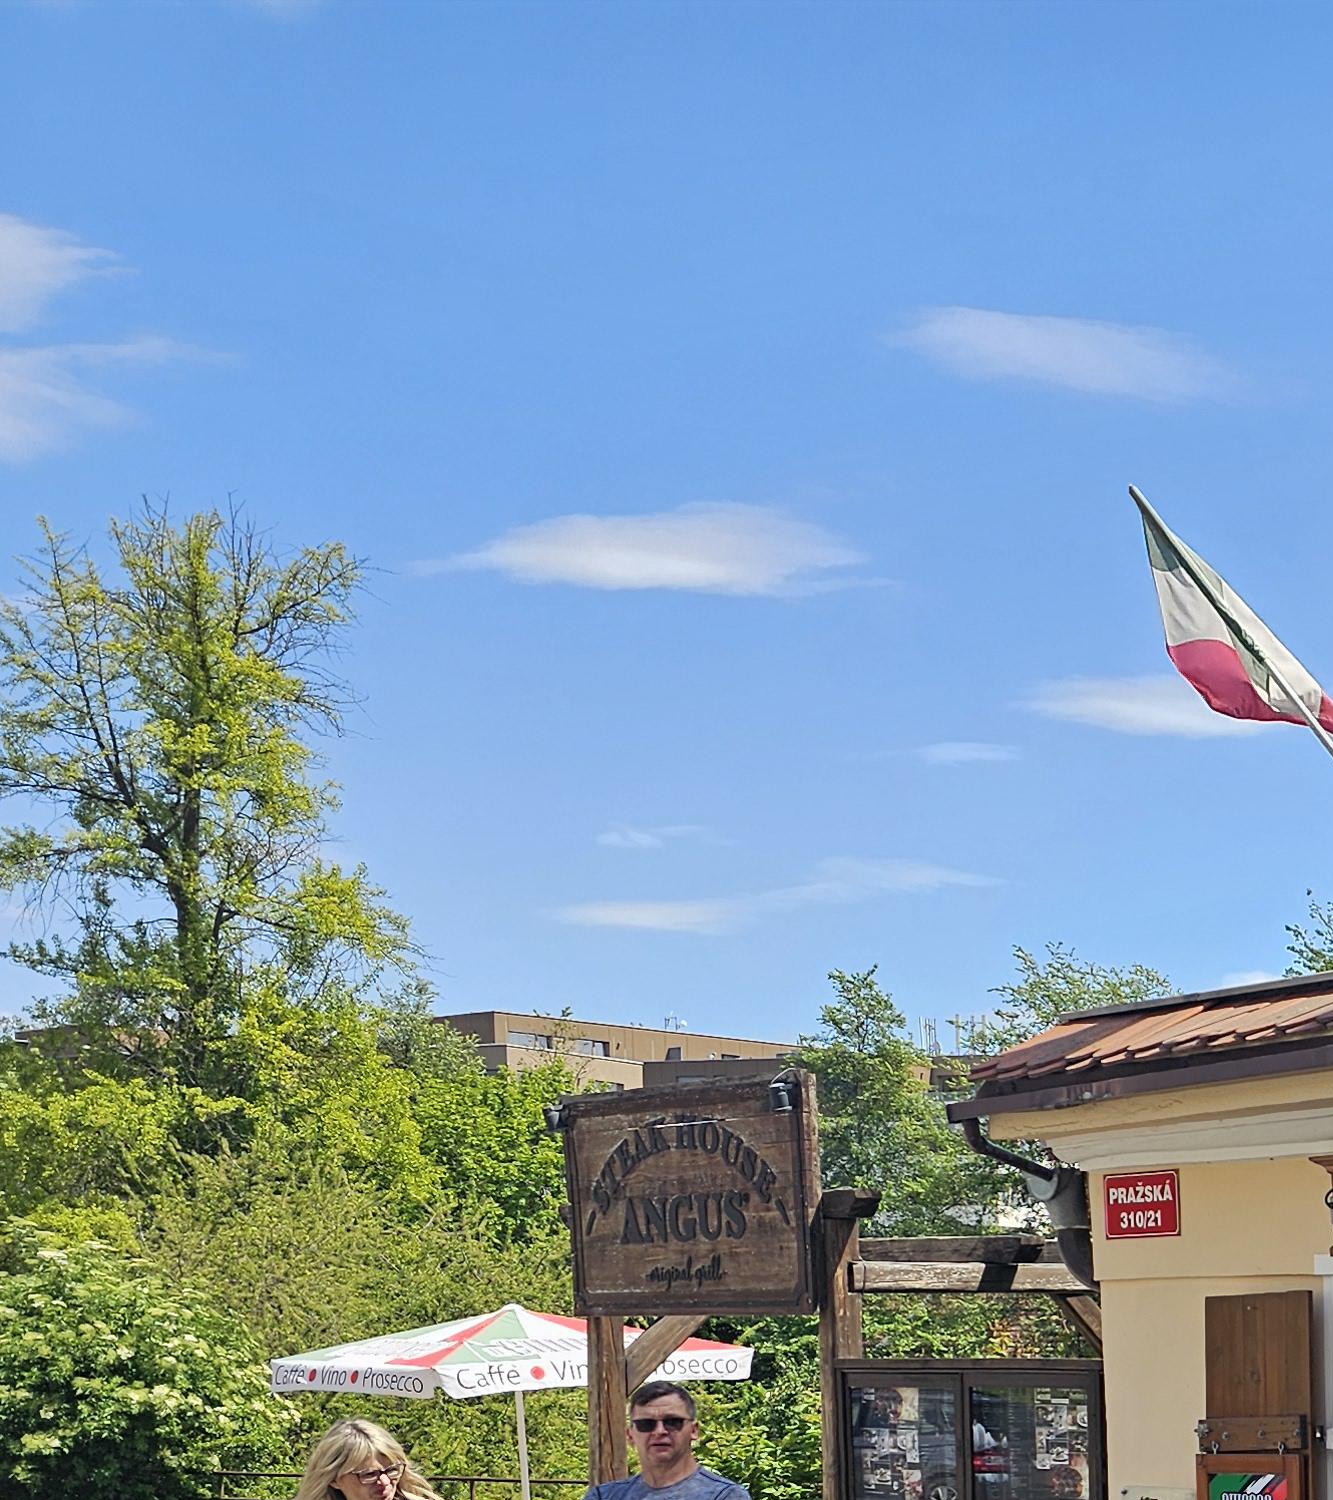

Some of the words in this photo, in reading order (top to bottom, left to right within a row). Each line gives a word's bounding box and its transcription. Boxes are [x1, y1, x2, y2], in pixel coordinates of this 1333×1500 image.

[592, 1116, 671, 1215] STEAK
[672, 1113, 777, 1204] HOUSE
[1109, 1179, 1173, 1205] PRAŽSKÁ
[1120, 1209, 1162, 1229] 310/21
[645, 1255, 693, 1292] original
[694, 1253, 724, 1289] grill
[321, 1366, 347, 1386] Vino
[362, 1367, 424, 1394] Prosecco
[550, 1361, 588, 1381] Vin
[655, 1356, 738, 1375] osecco
